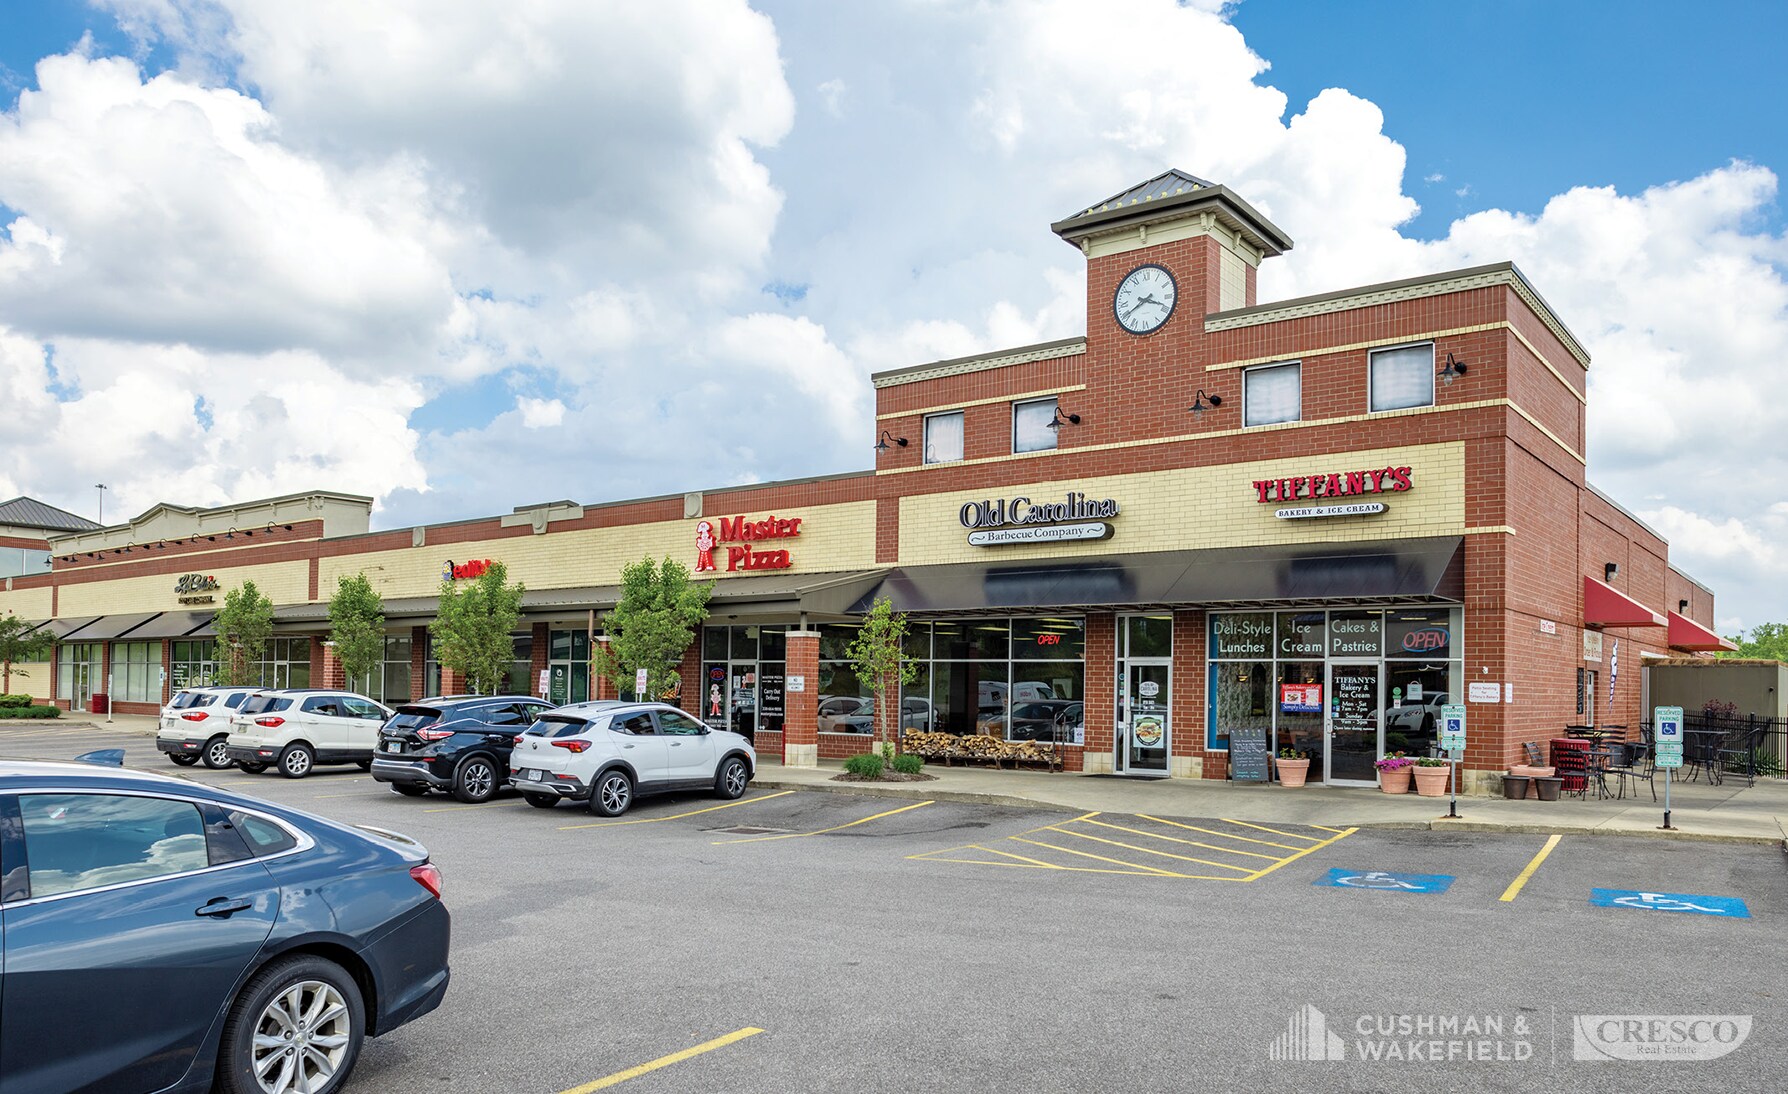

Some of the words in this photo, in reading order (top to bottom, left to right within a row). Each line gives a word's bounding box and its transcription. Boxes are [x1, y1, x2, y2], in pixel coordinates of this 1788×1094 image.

[1252, 466, 1412, 503] TIFFANY'S
[959, 499, 1005, 529] Old
[1008, 492, 1117, 525] Carolina
[1278, 508, 1313, 517] BAKERY
[1346, 504, 1380, 513] CREAM
[718, 515, 802, 542] Master
[987, 531, 1033, 542] Barbecue
[1034, 527, 1085, 539] Company
[726, 544, 793, 572] Pizza
[1213, 620, 1272, 637] Deli-Style
[1291, 620, 1312, 633] Ice
[1331, 619, 1366, 633] Cakes
[1369, 620, 1379, 633] &
[1038, 635, 1060, 645] OPEN
[1219, 639, 1266, 653] Lunches
[1281, 638, 1323, 652] Cream
[1333, 638, 1377, 652] Pastries
[1403, 631, 1446, 648] OPEN
[1340, 684, 1362, 692] Bakery
[1350, 690, 1371, 698] Cream
